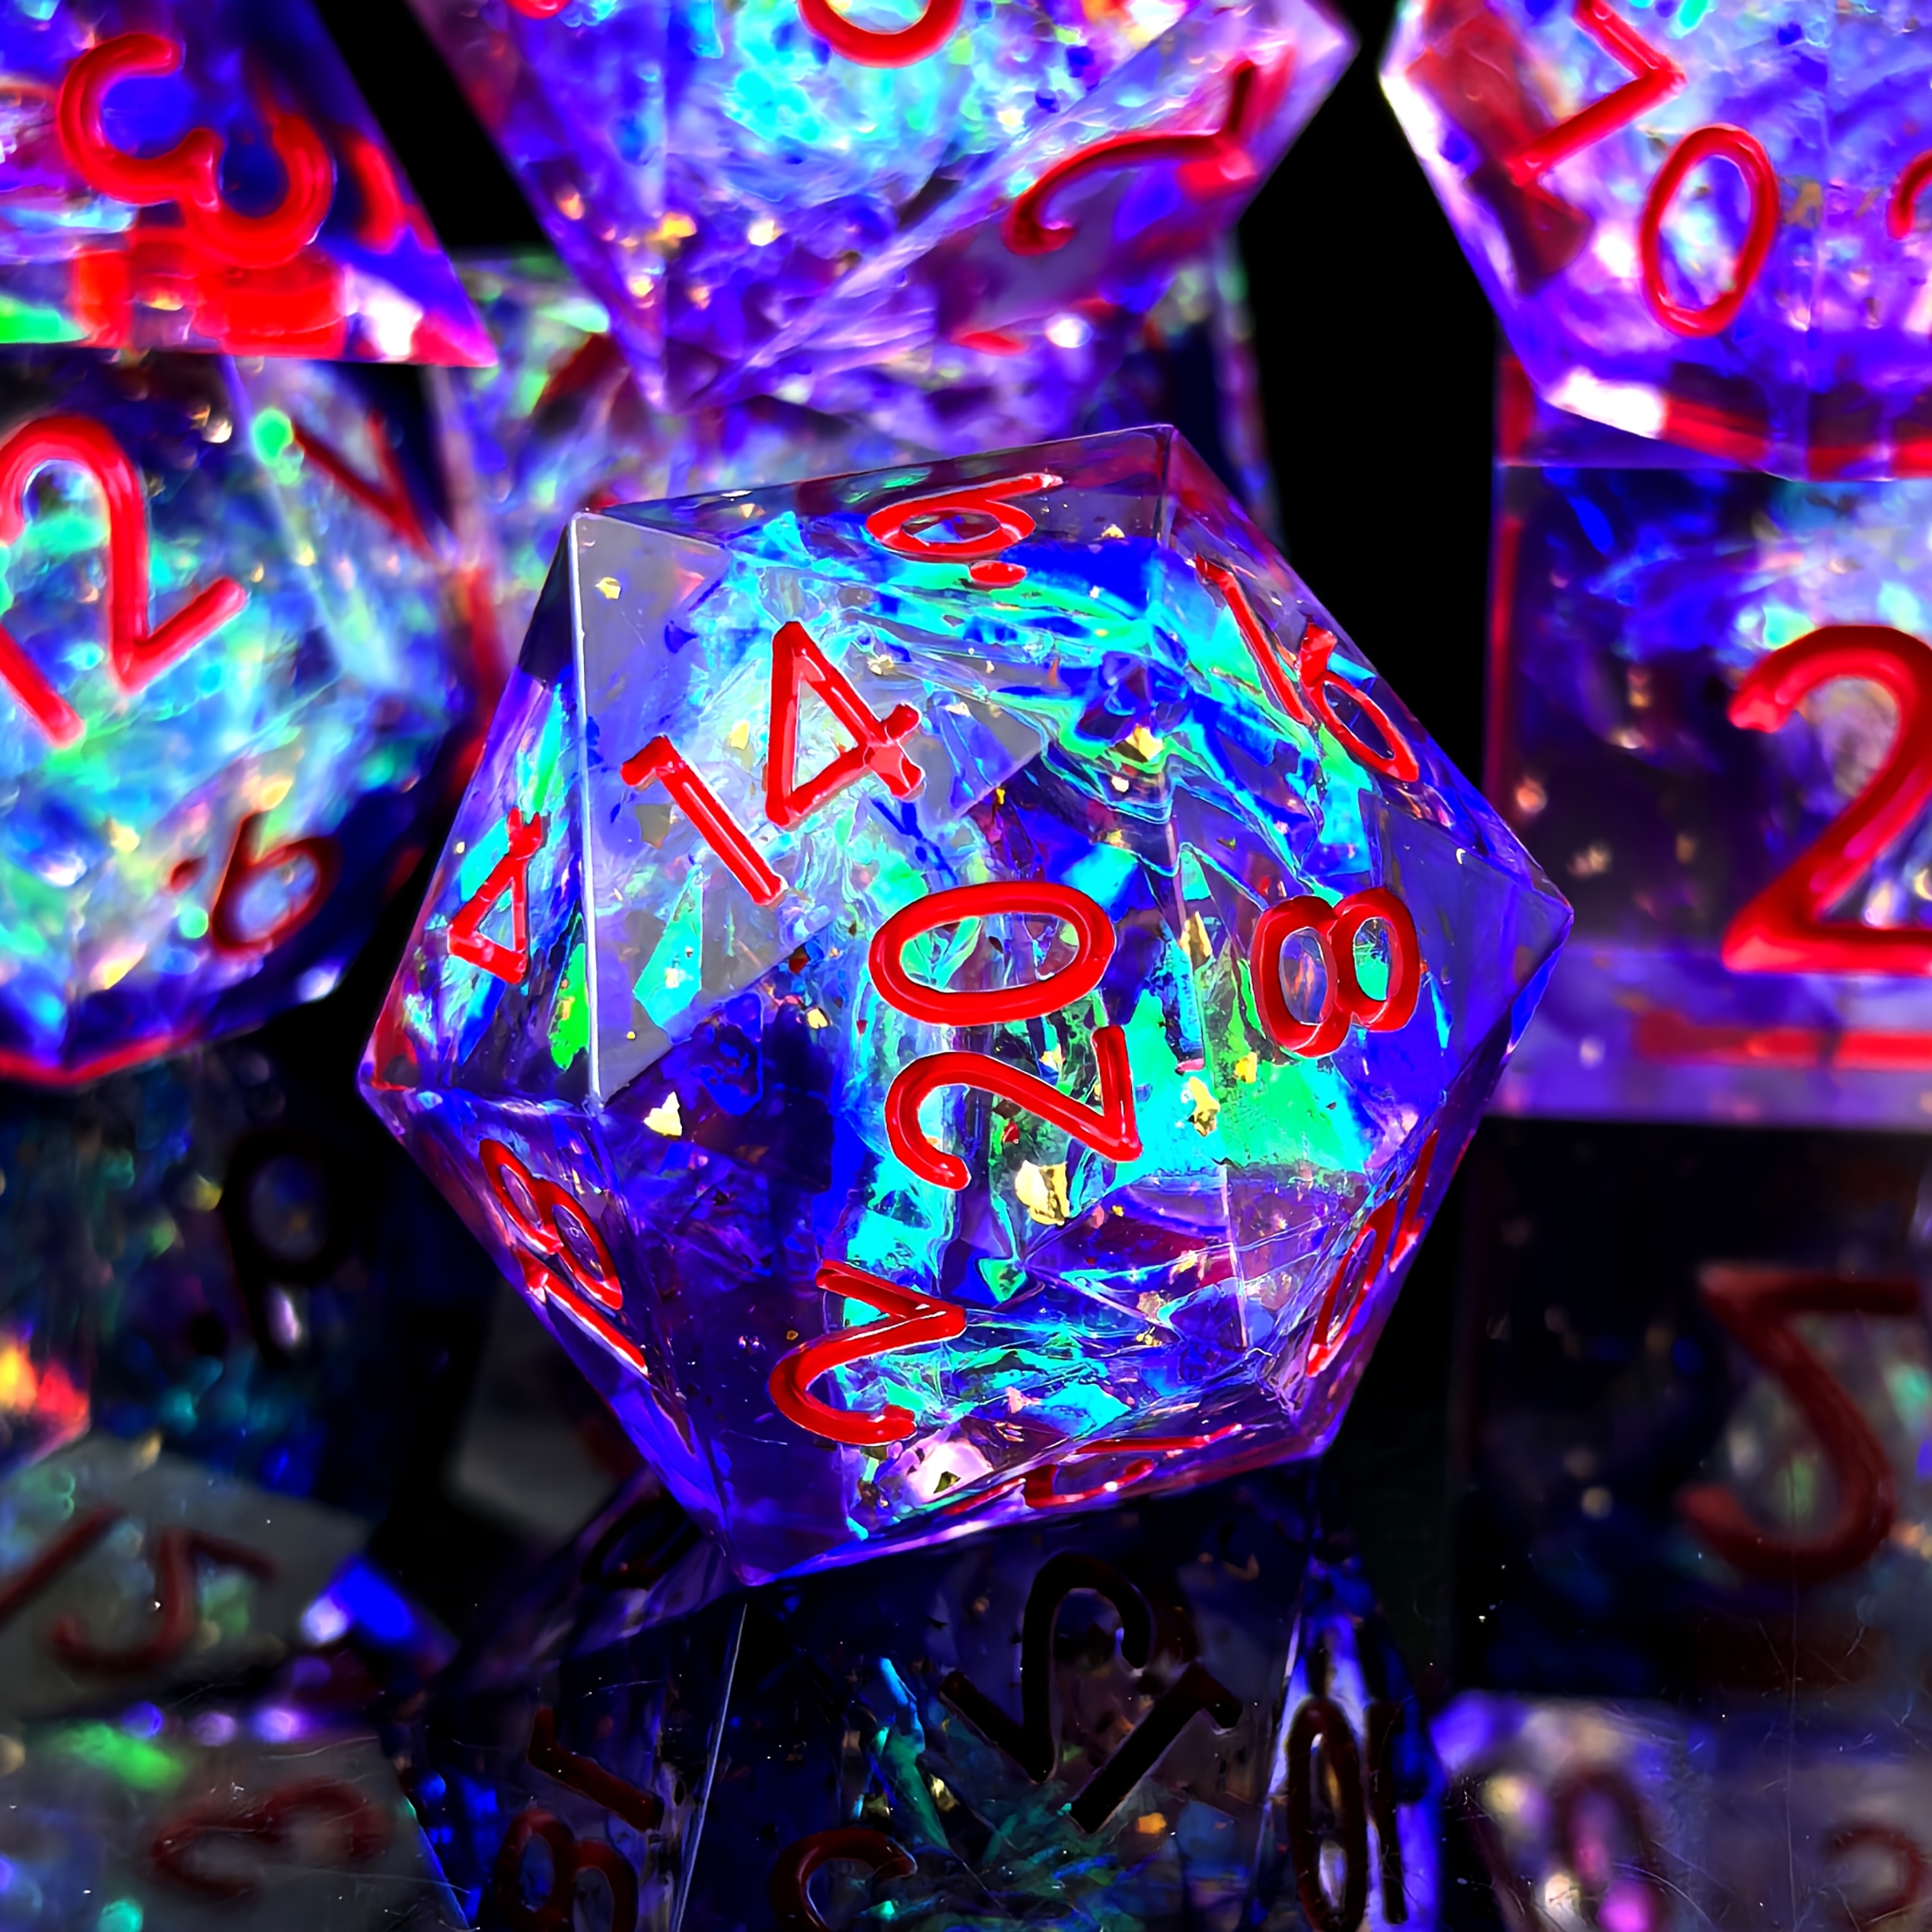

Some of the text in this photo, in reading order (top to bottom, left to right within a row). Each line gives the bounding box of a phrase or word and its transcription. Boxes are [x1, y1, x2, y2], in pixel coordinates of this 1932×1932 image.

[621, 621, 926, 906] 14
[1195, 554, 1419, 783] 16
[448, 807, 542, 984] 4
[1722, 624, 1932, 978] 2
[869, 881, 1143, 1191] 20
[1250, 886, 1420, 1058] 8
[768, 1259, 967, 1446] 2
